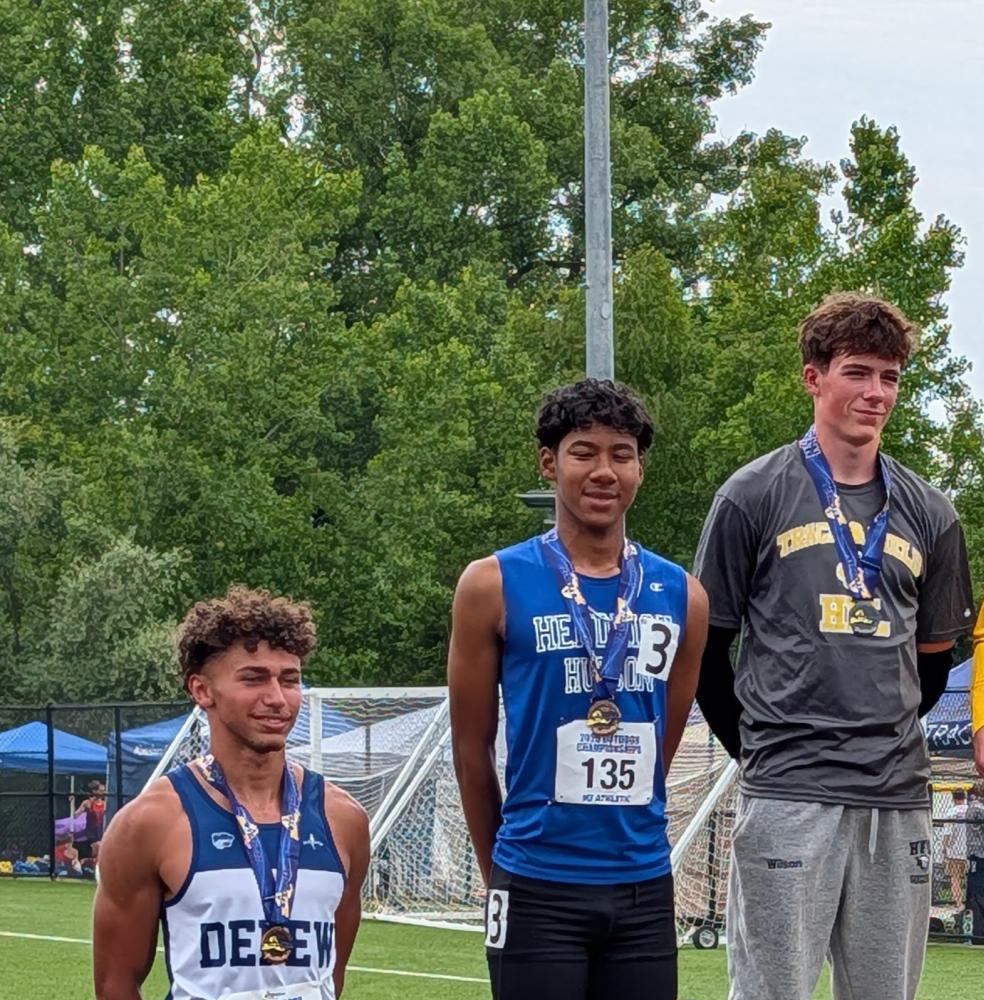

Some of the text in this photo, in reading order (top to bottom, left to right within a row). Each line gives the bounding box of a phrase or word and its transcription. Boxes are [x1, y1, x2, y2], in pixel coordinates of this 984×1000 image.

[776, 521, 837, 559] TRAC
[645, 623, 672, 675] 3
[581, 757, 636, 790] 135
[200, 919, 335, 969] DEEW
